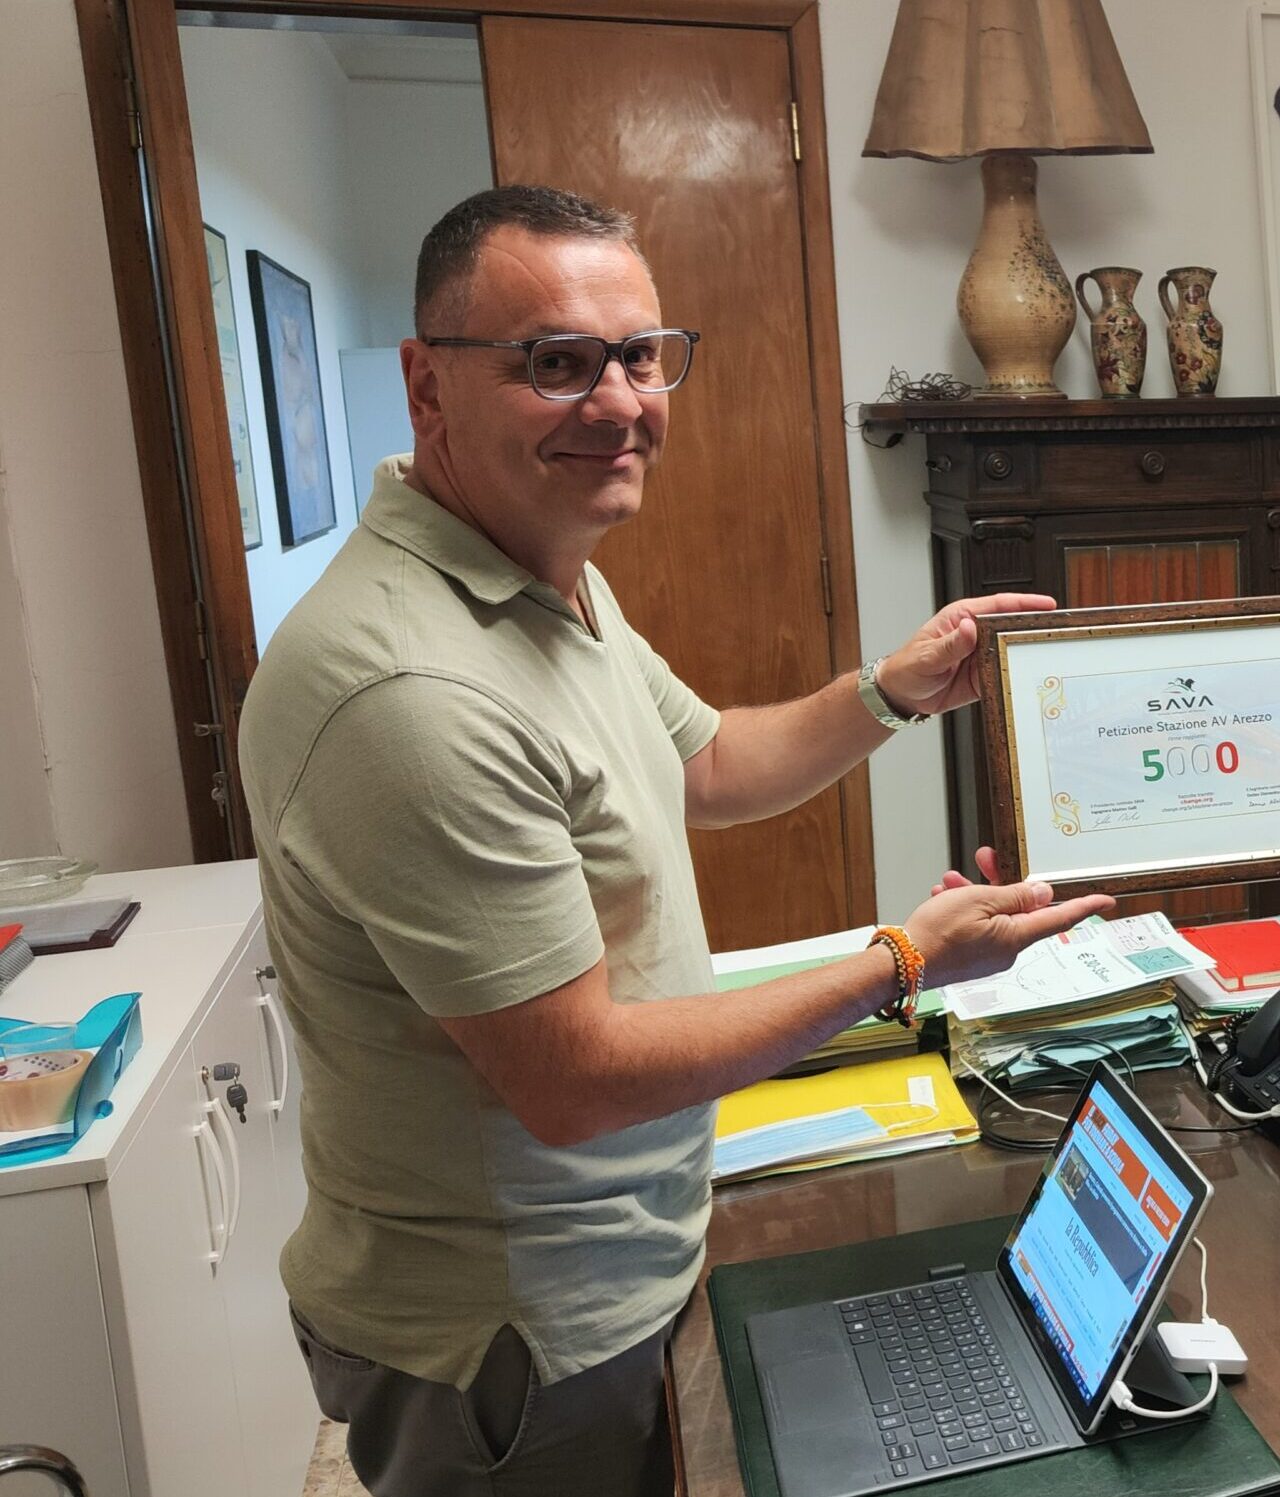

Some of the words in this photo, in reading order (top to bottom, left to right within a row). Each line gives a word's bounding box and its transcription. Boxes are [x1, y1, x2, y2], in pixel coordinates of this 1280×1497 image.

[1147, 695, 1214, 712] SAVA
[1098, 724, 1153, 737] Petizione
[1156, 719, 1208, 732] Stazione
[1211, 715, 1228, 727] AV
[1232, 712, 1273, 724] Arezzo
[1142, 741, 1239, 782] 5000
[1070, 1224, 1099, 1278] Repubblica
